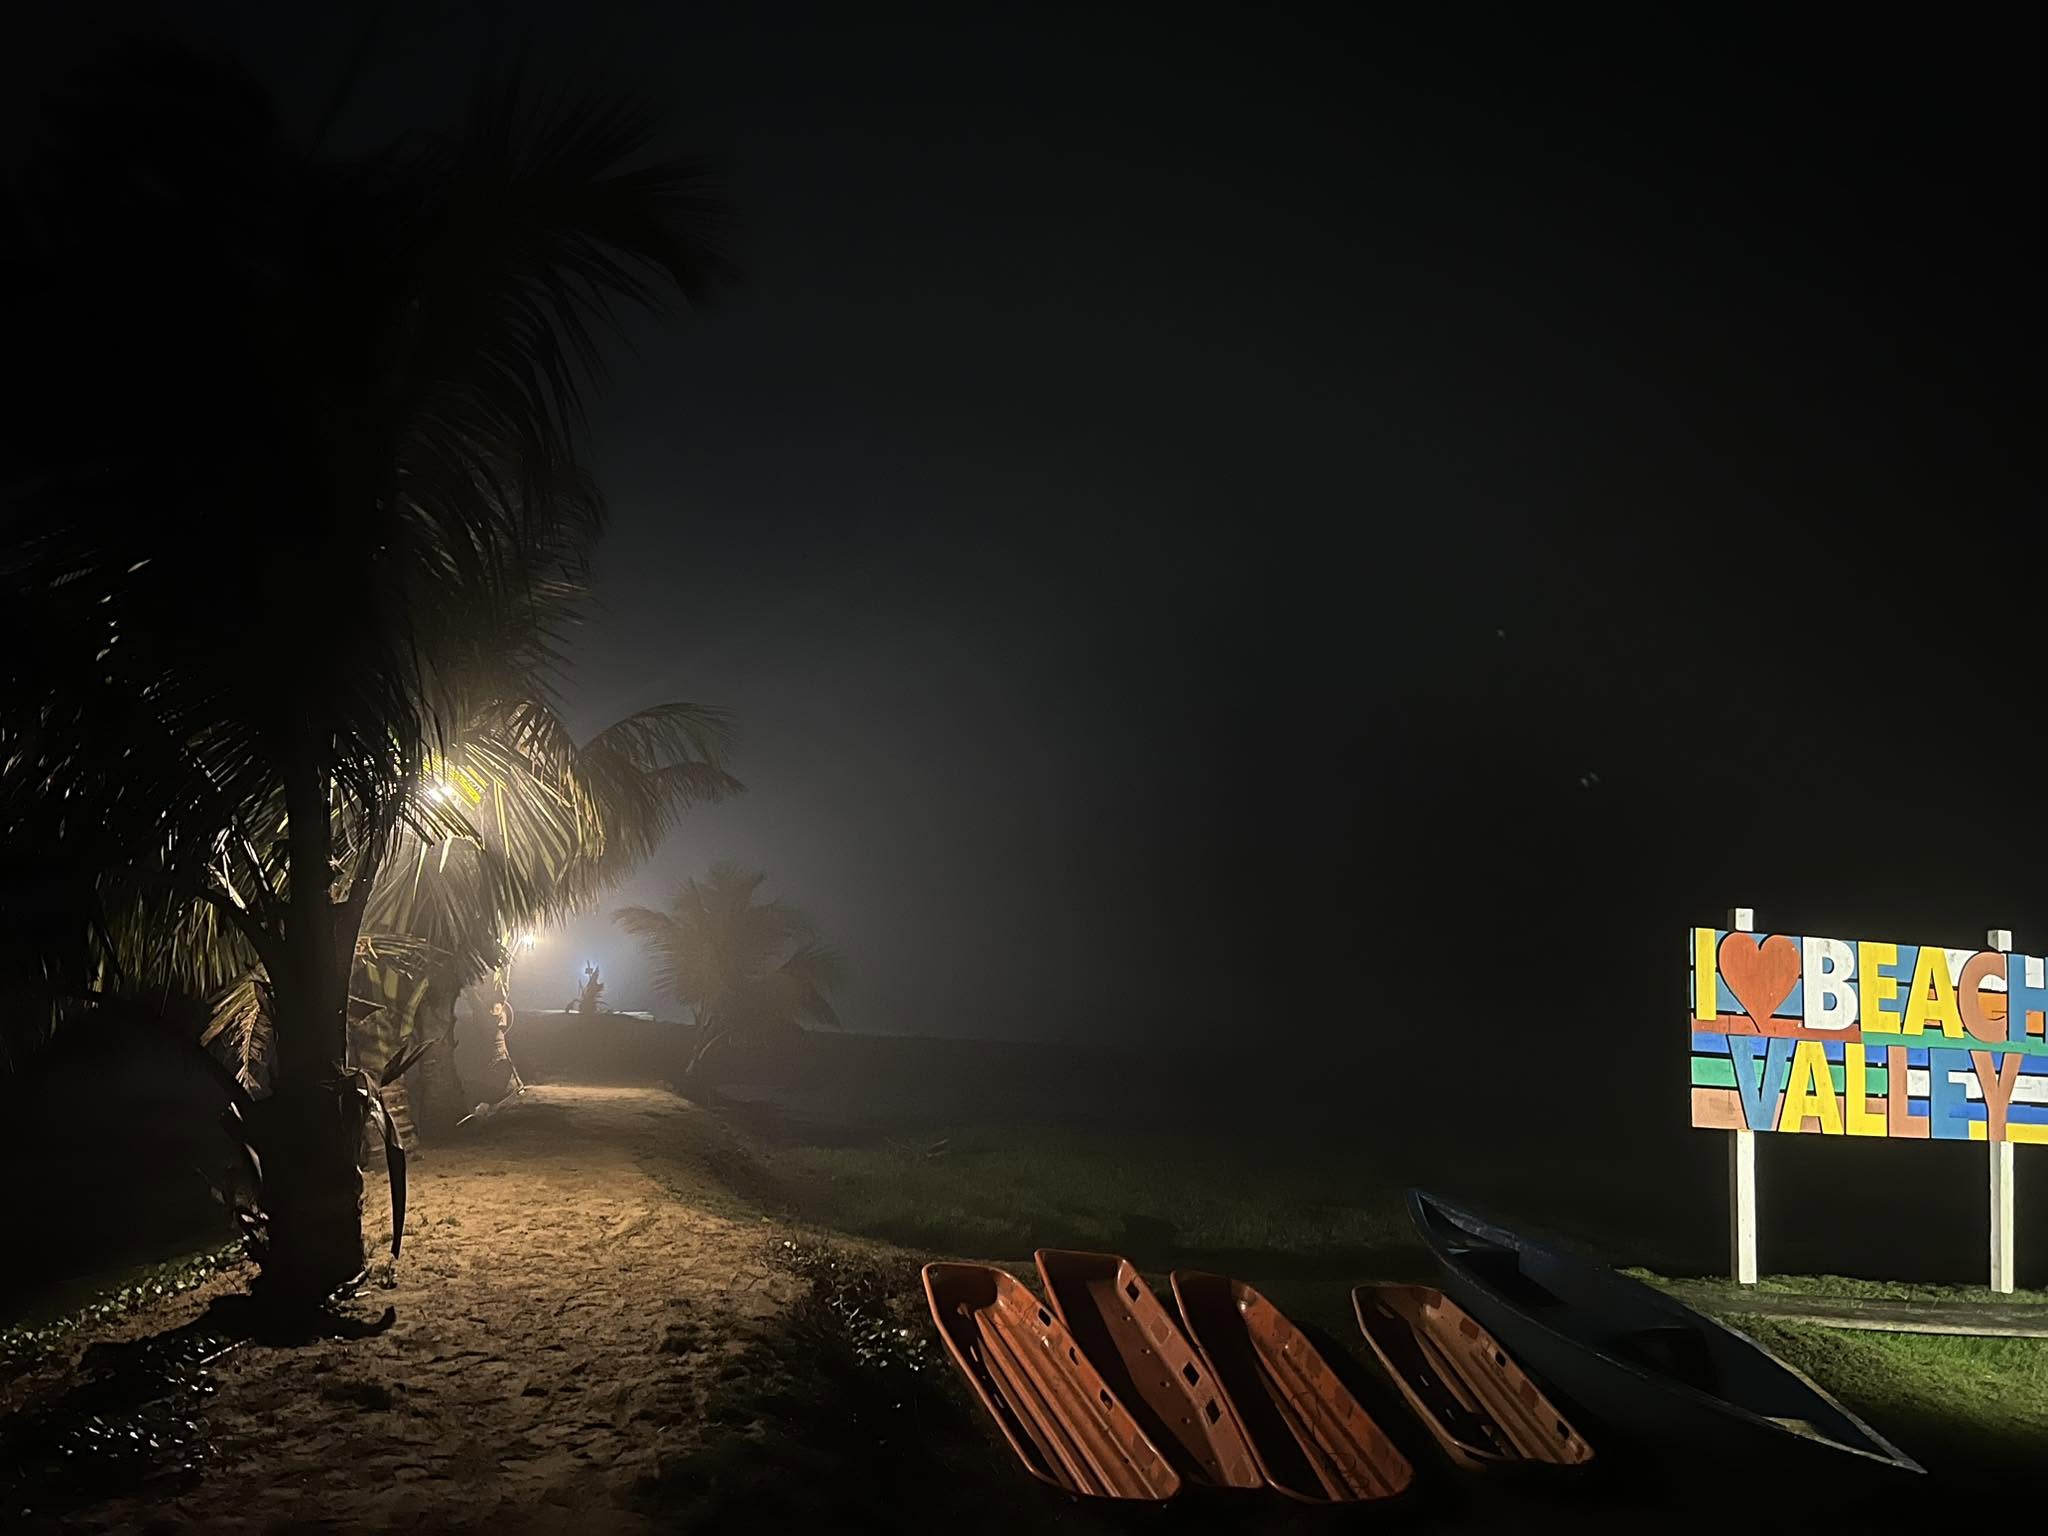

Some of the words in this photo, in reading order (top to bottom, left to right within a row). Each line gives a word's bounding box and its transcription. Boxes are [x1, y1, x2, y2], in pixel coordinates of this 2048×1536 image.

[1695, 927, 1717, 1021] I
[1802, 936, 2048, 1044] BEACH
[1727, 1034, 2022, 1142] VALLEY
